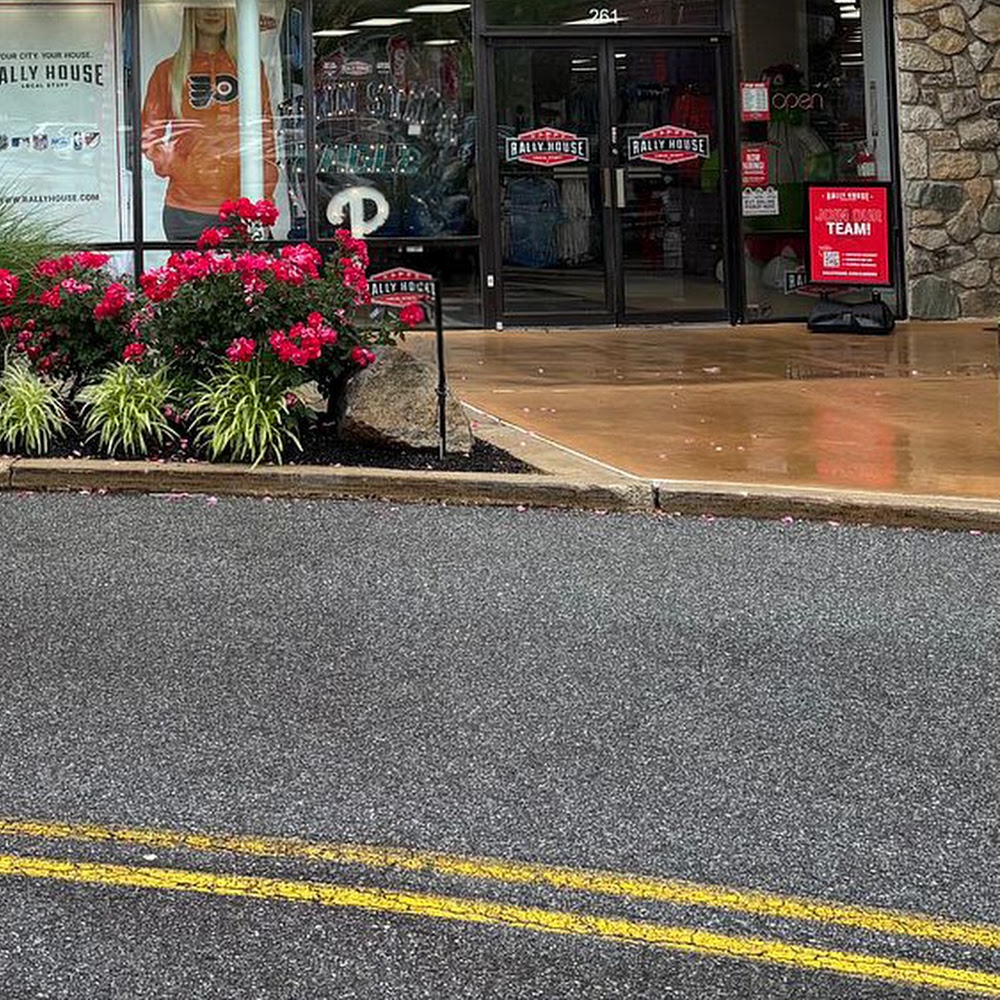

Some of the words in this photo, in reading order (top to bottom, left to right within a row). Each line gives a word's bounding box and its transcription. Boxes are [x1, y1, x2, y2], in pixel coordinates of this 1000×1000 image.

[589, 8, 618, 25] 261
[41, 52, 62, 60] YOUR
[45, 63, 104, 86] HOUSE
[510, 141, 544, 156] RALLY
[547, 141, 585, 156] HOUSE
[632, 139, 665, 155] RALLY
[668, 139, 705, 153] HOUSE
[826, 222, 871, 236] TEAM!
